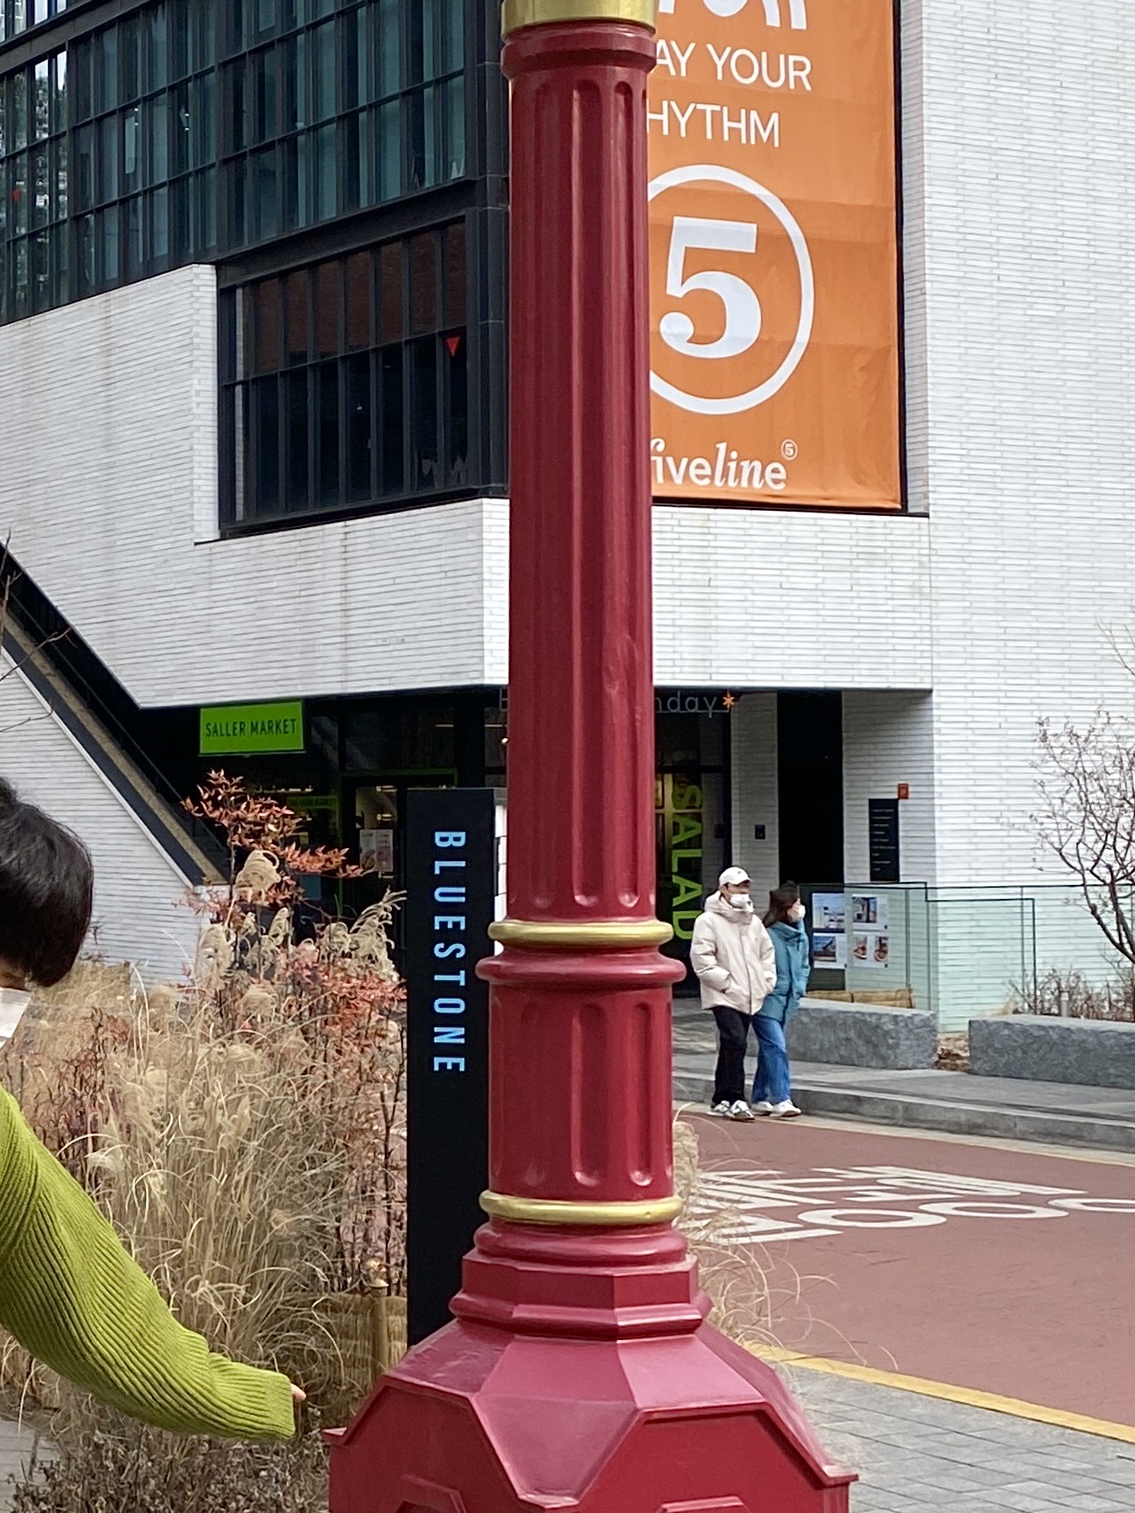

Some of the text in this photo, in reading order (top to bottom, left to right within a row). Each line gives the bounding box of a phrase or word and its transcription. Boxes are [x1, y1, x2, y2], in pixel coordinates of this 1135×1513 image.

[650, 39, 812, 91] AY YOUR
[646, 98, 779, 148] HYTHM
[659, 216, 762, 359] 5
[205, 718, 297, 737] SALLER MARKET
[671, 784, 703, 940] SALAD
[433, 831, 466, 1072] BLUESTONE
